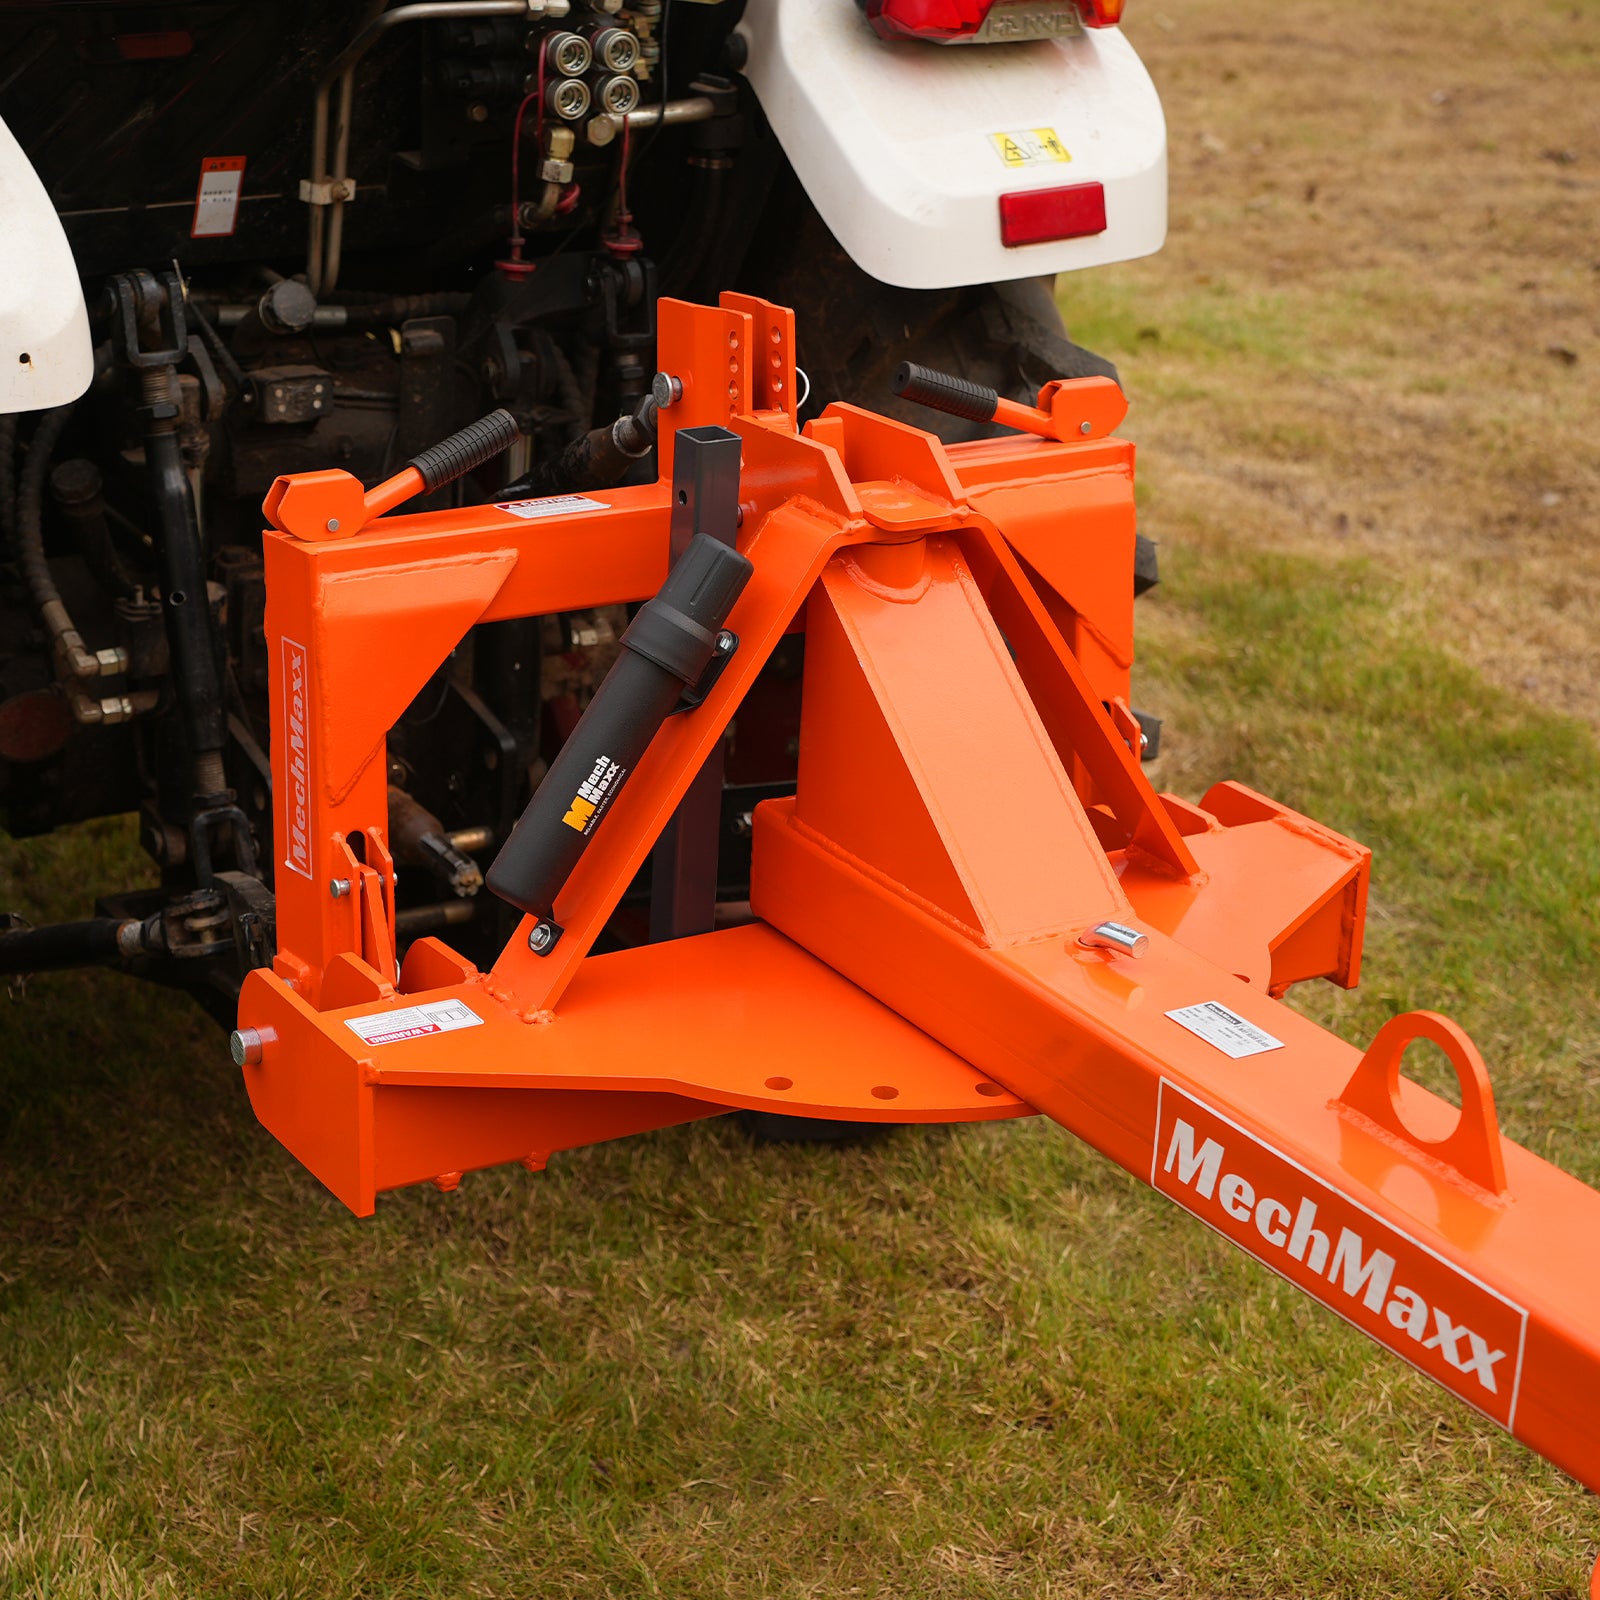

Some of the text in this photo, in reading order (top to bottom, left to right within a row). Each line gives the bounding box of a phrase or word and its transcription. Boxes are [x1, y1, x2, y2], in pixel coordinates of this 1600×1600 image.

[290, 650, 307, 868] MechMaxx
[577, 755, 610, 799] Mech
[587, 761, 620, 805] Maxx
[370, 1027, 425, 1044] WARNING
[1163, 1118, 1507, 1395] MechMaxx
